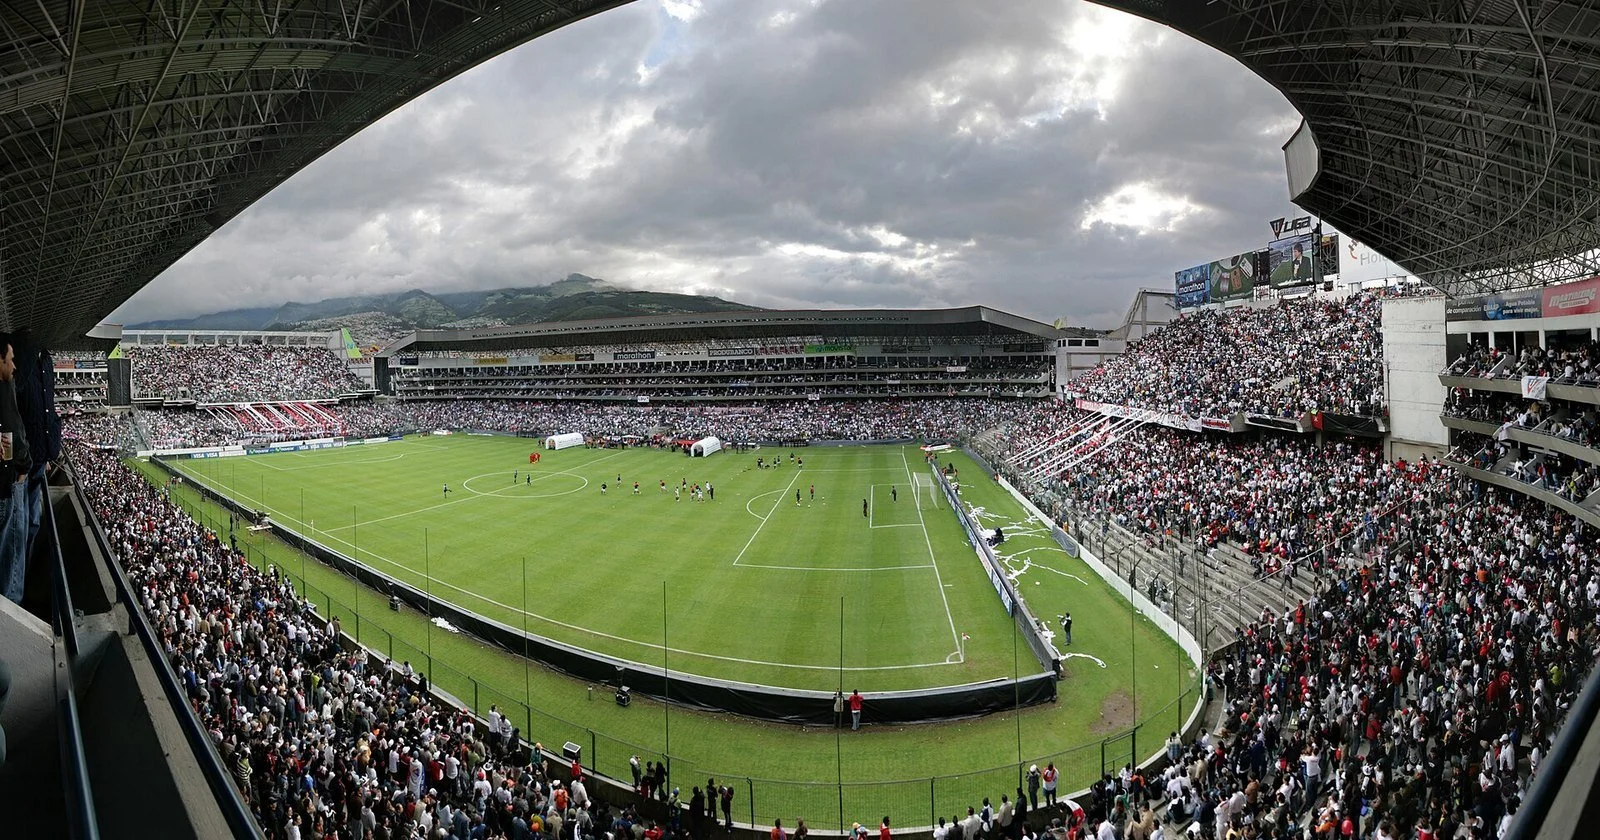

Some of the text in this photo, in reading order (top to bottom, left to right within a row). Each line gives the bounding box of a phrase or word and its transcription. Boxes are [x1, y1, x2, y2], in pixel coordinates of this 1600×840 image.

[1283, 216, 1311, 232] LIGA
[1178, 282, 1205, 293] marathon
[1453, 306, 1482, 314] comparación
[617, 351, 652, 359] marathon
[709, 348, 753, 357] PRODUBANCO
